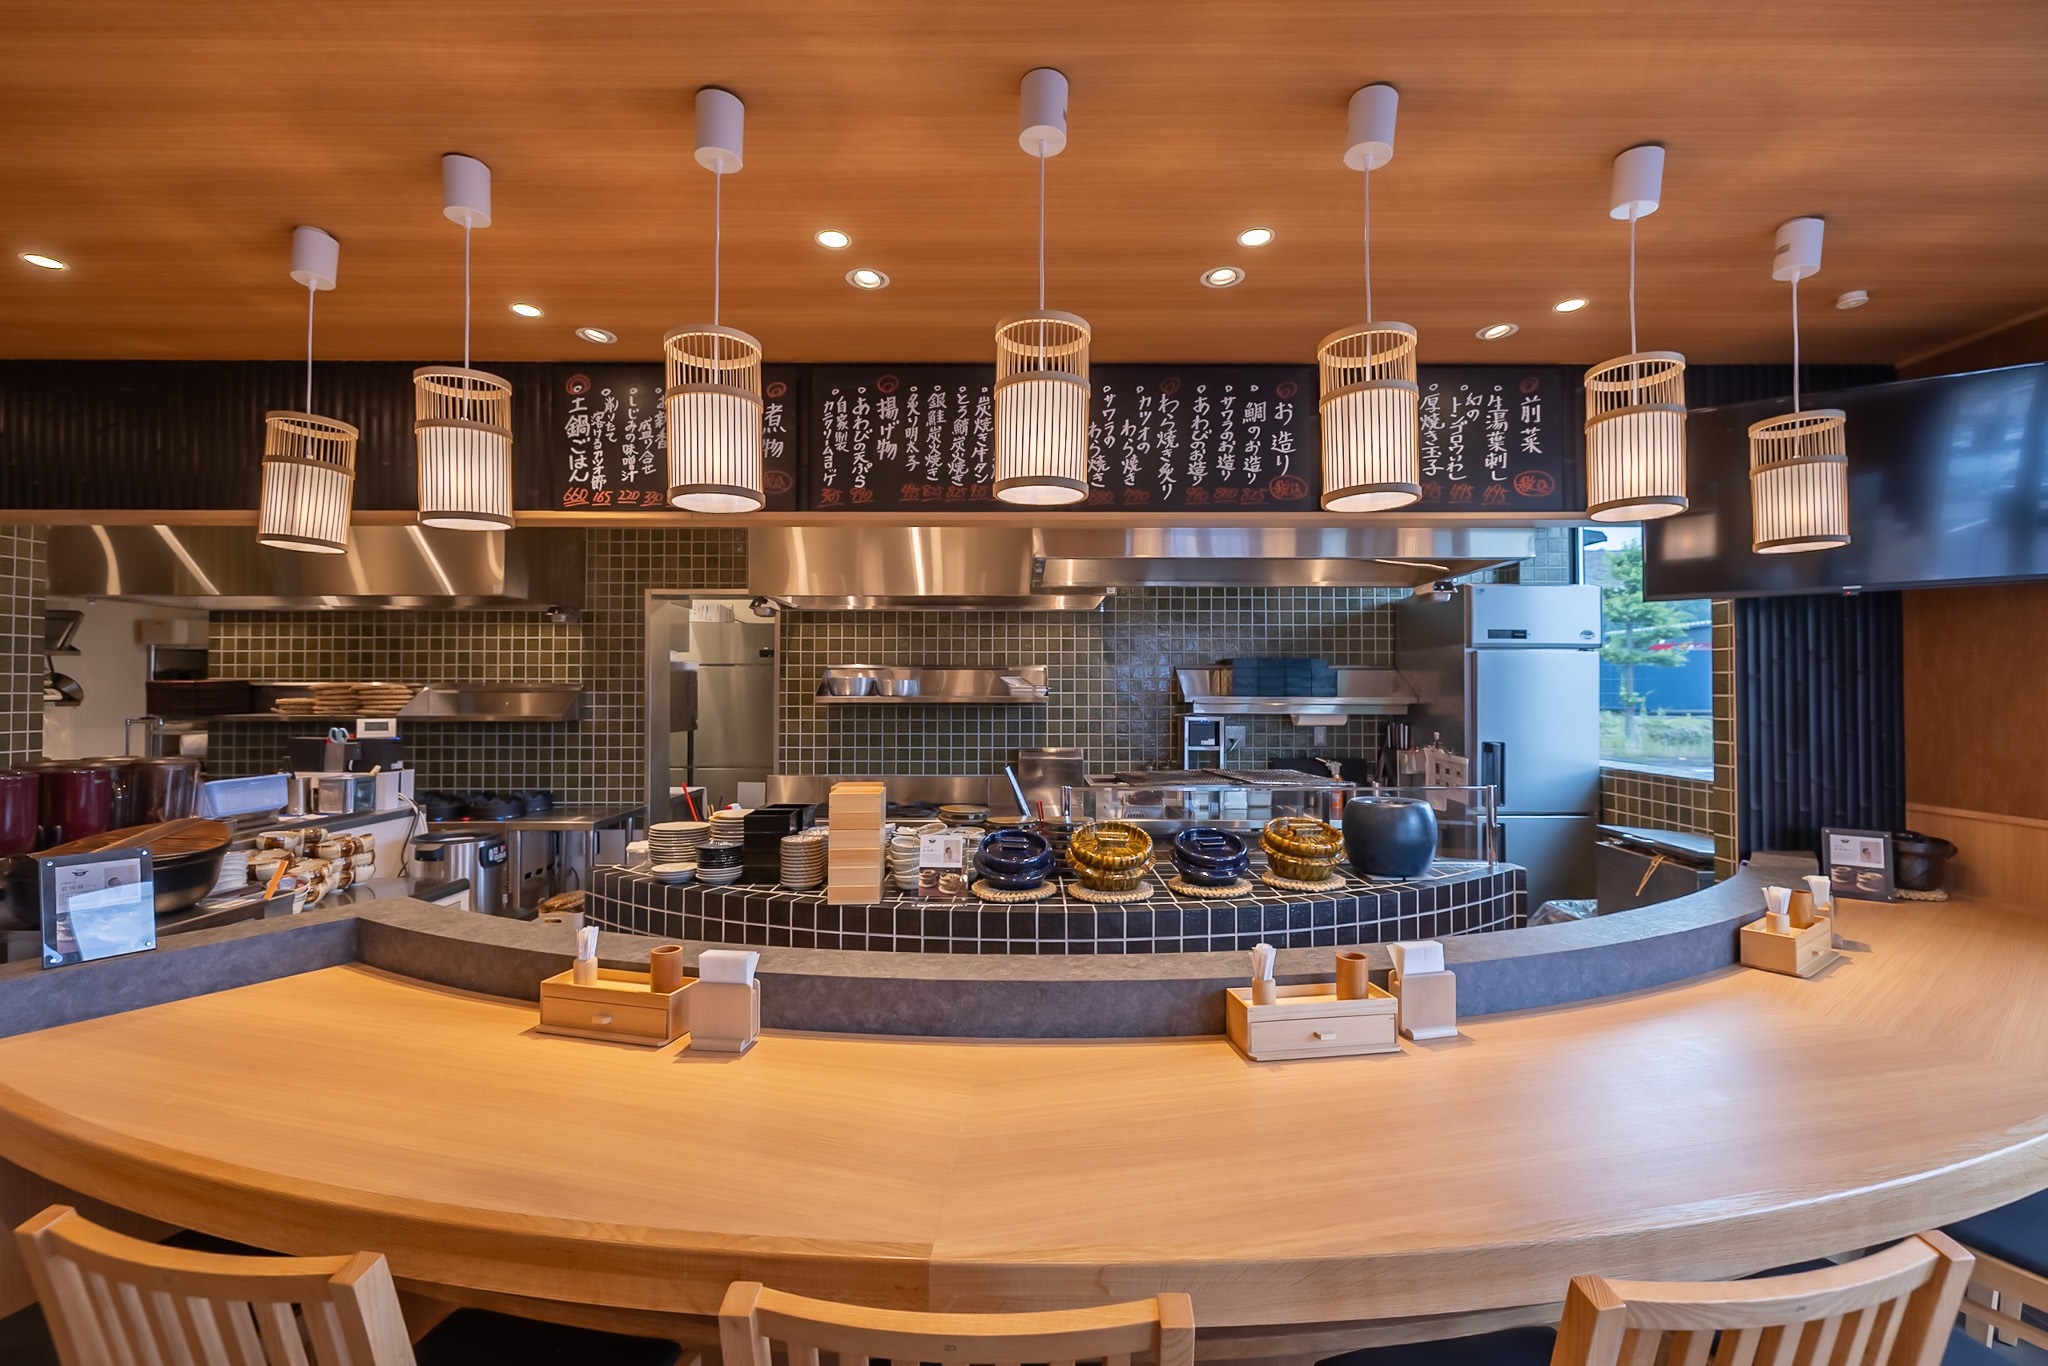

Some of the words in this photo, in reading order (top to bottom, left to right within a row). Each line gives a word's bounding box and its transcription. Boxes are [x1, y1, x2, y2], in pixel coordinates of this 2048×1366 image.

[603, 397, 618, 443] 削りたて
[762, 403, 786, 458] 煮物
[835, 396, 849, 452] 自家製
[876, 396, 900, 460] 揚げ物
[905, 394, 921, 472] 炙り明太子
[925, 392, 947, 481] 銀鮭炭火焼き
[1102, 394, 1116, 449] サワラの
[1136, 395, 1151, 454] カツオの
[1216, 396, 1236, 481] サワラのお造り
[1270, 401, 1296, 476] お造り
[1420, 393, 1445, 476] 厚焼き玉子
[1465, 392, 1482, 421] 幻の
[1485, 395, 1508, 481] 生湯葉刺し
[1520, 395, 1542, 454] 前菜
[564, 397, 590, 483] 土鍋ごはん
[621, 397, 640, 483] しじみの味噌汁
[638, 417, 656, 475] 盛り合せ
[822, 401, 836, 486] カニクリームコロッケ
[852, 397, 873, 488] あわびの天ぷら
[948, 394, 969, 486] とろ鯖炭火焼き
[971, 396, 994, 484] 炭焼き牛タン
[1088, 421, 1110, 488] わら焼き
[1120, 419, 1142, 486] わら焼き
[1156, 393, 1180, 500] わら焼き炙り
[1187, 397, 1211, 486] あわびのお造り
[1242, 401, 1266, 484] 鯛のお造り
[563, 488, 588, 502] 660
[593, 491, 613, 502] 165
[618, 490, 640, 500] 220
[644, 492, 664, 503] 330
[850, 488, 873, 499] 990
[946, 486, 967, 497] 825
[1240, 488, 1268, 502] 825
[1483, 484, 1511, 502] 495
